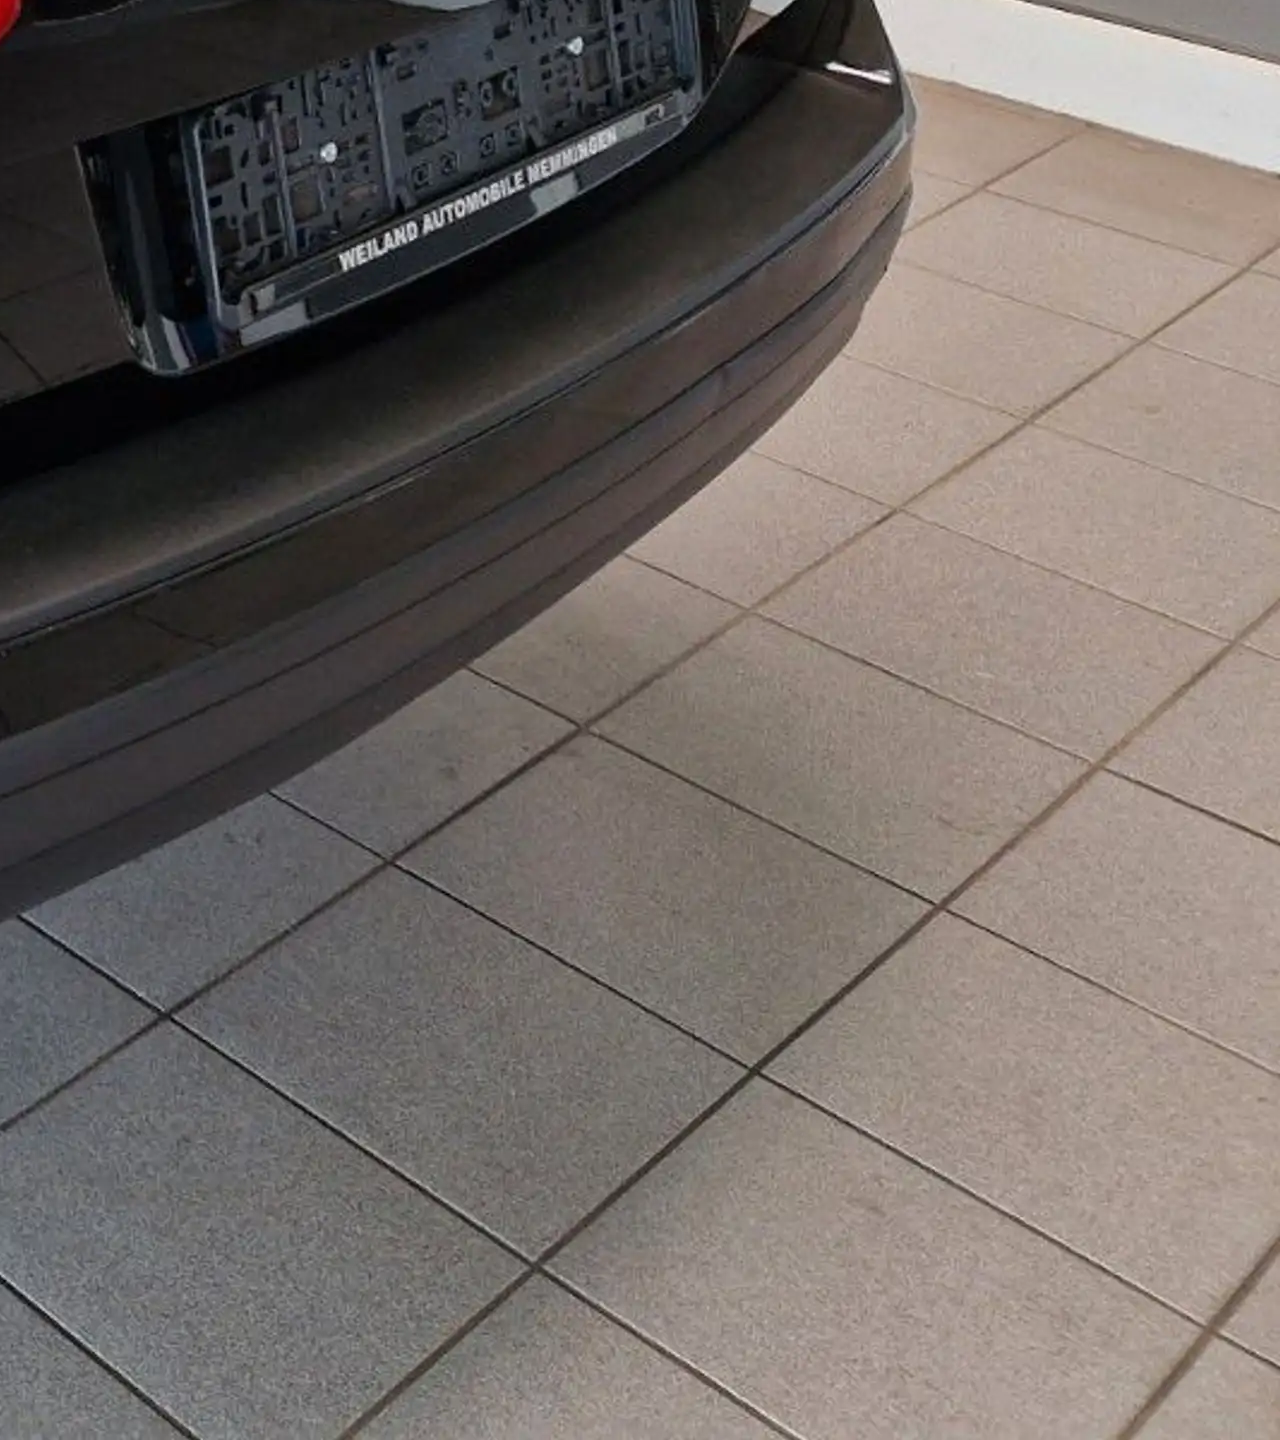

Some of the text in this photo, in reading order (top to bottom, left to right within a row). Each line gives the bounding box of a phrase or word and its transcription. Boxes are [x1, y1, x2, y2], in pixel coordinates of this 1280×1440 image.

[338, 124, 619, 272] WEILAND AUTOMOBILE MEMMINGEN
